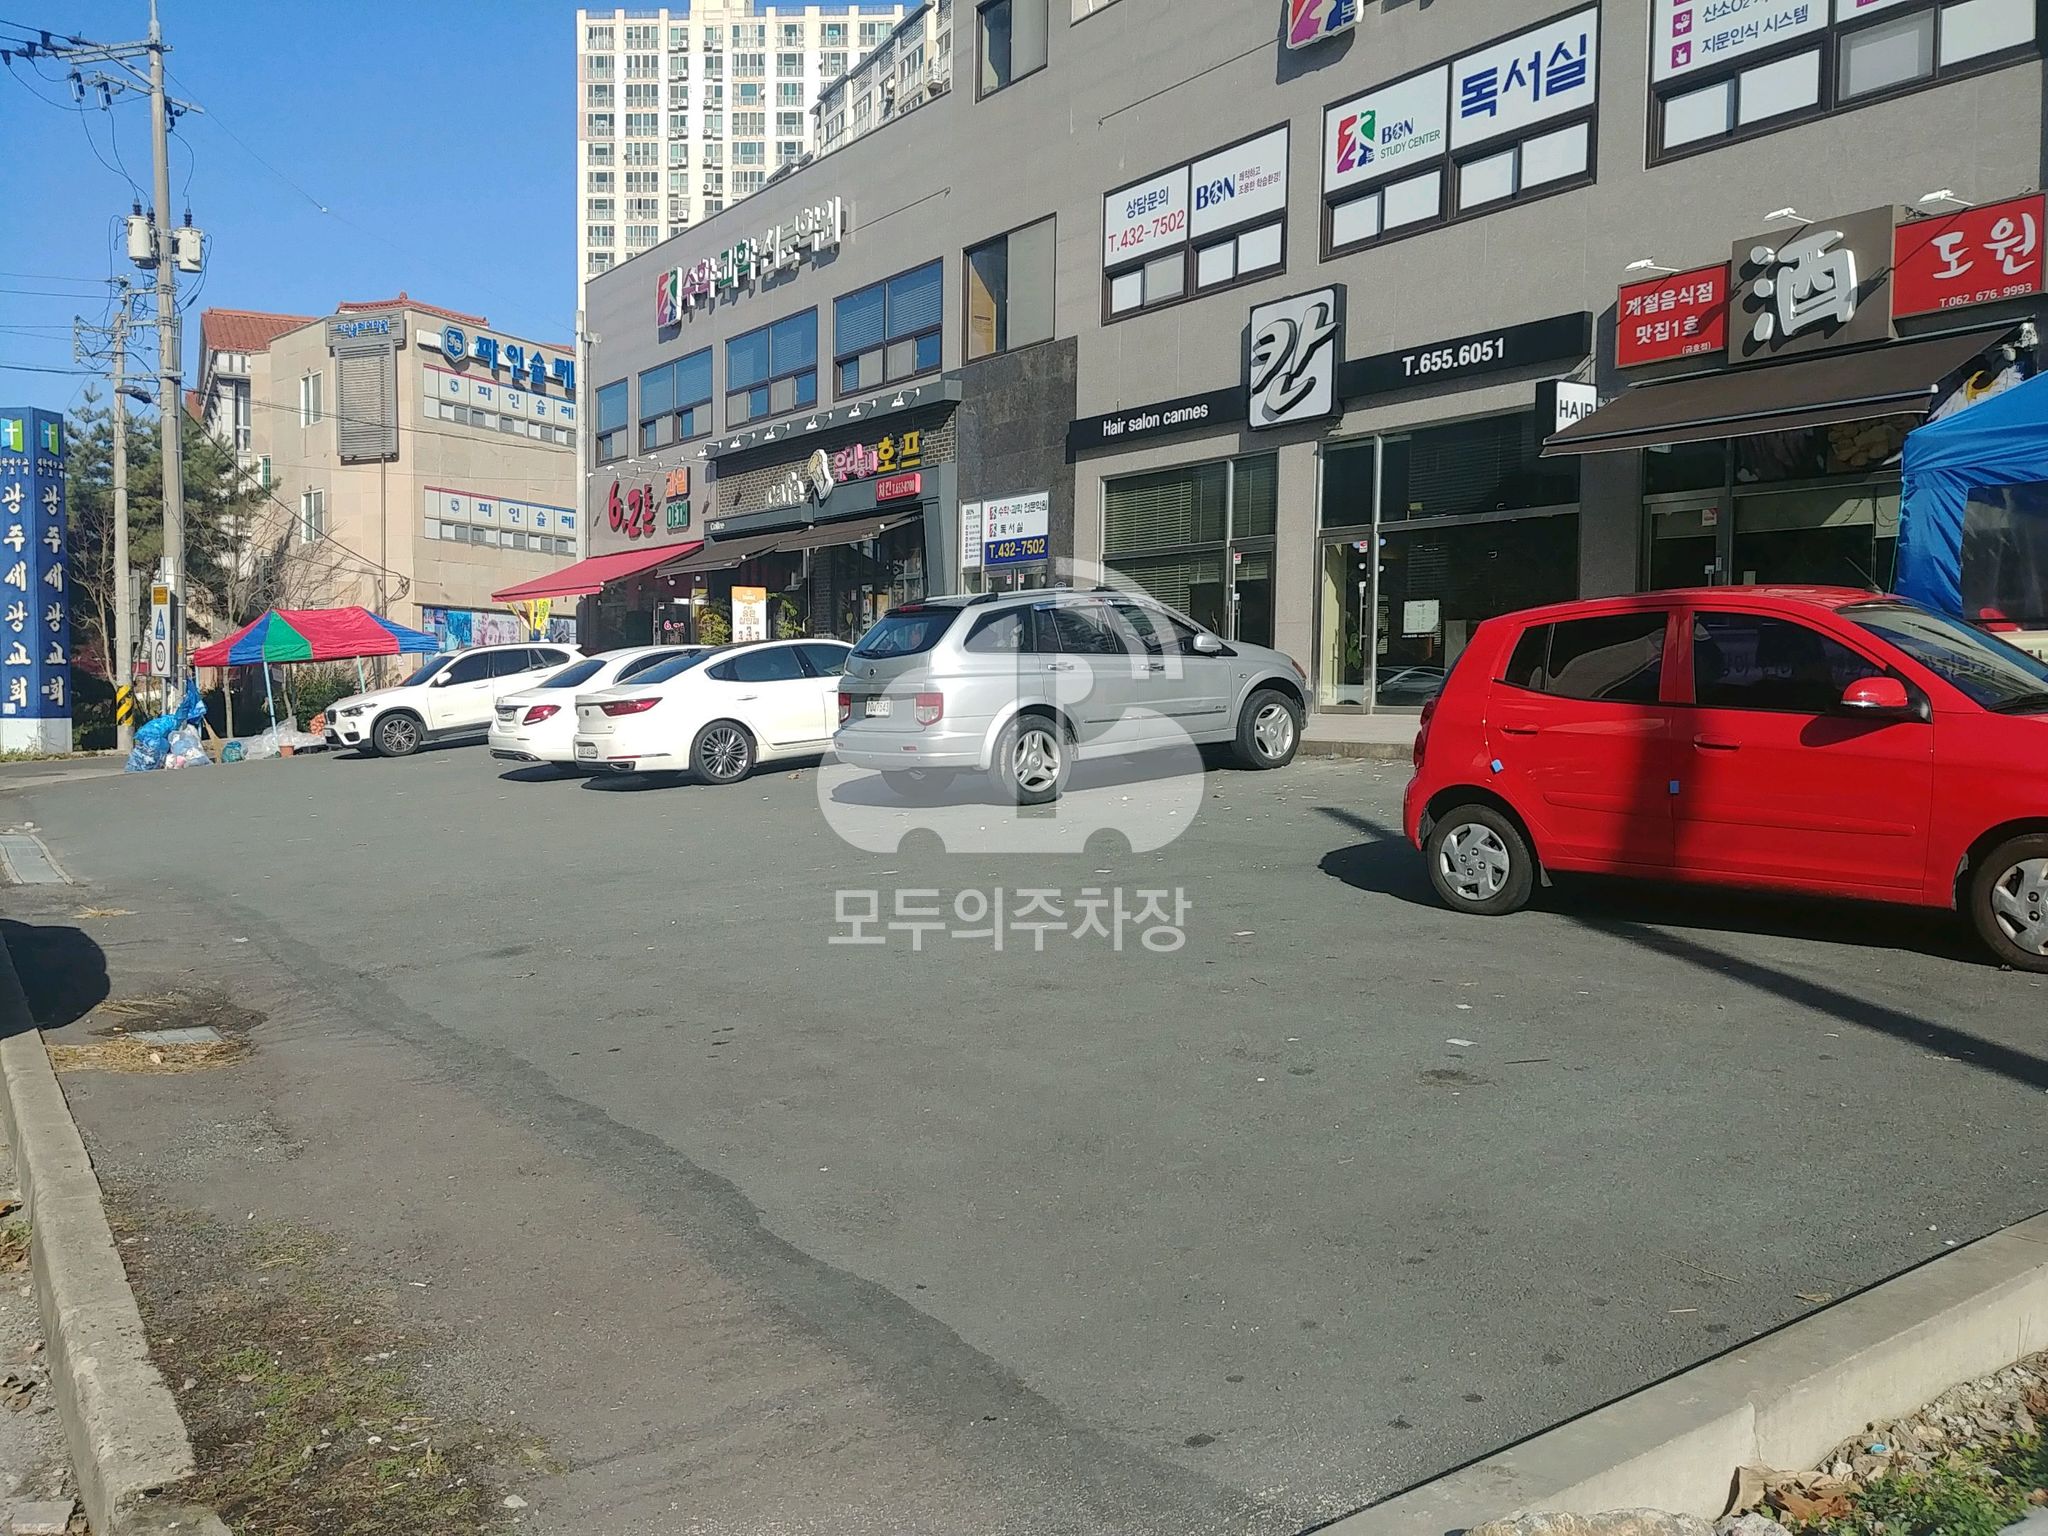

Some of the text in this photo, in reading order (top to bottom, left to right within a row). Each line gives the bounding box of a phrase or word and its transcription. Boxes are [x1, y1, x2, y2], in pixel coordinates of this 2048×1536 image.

[1701, 4, 1809, 53] 지문인식 시스템
[1461, 33, 1587, 119] 독서실
[1380, 129, 1441, 159] STUDY CENTER
[1381, 117, 1414, 145] BON
[1126, 186, 1169, 219] 상담문의
[1196, 174, 1236, 211] BON
[1108, 209, 1185, 253] T.432-7502
[1625, 281, 1713, 317] 계절음식점
[1749, 230, 1859, 344] 酒
[2002, 282, 2033, 297] 9993
[1636, 315, 1699, 345] 맛집1호
[1402, 338, 1505, 377] T.655.6051
[1102, 403, 1209, 437] Hair salon cannes
[877, 430, 921, 473] 호프
[878, 481, 892, 498] 치킨
[1024, 499, 1047, 514] 전문학원
[1000, 522, 1024, 535] 독서실
[989, 538, 1045, 559] T.432-7502
